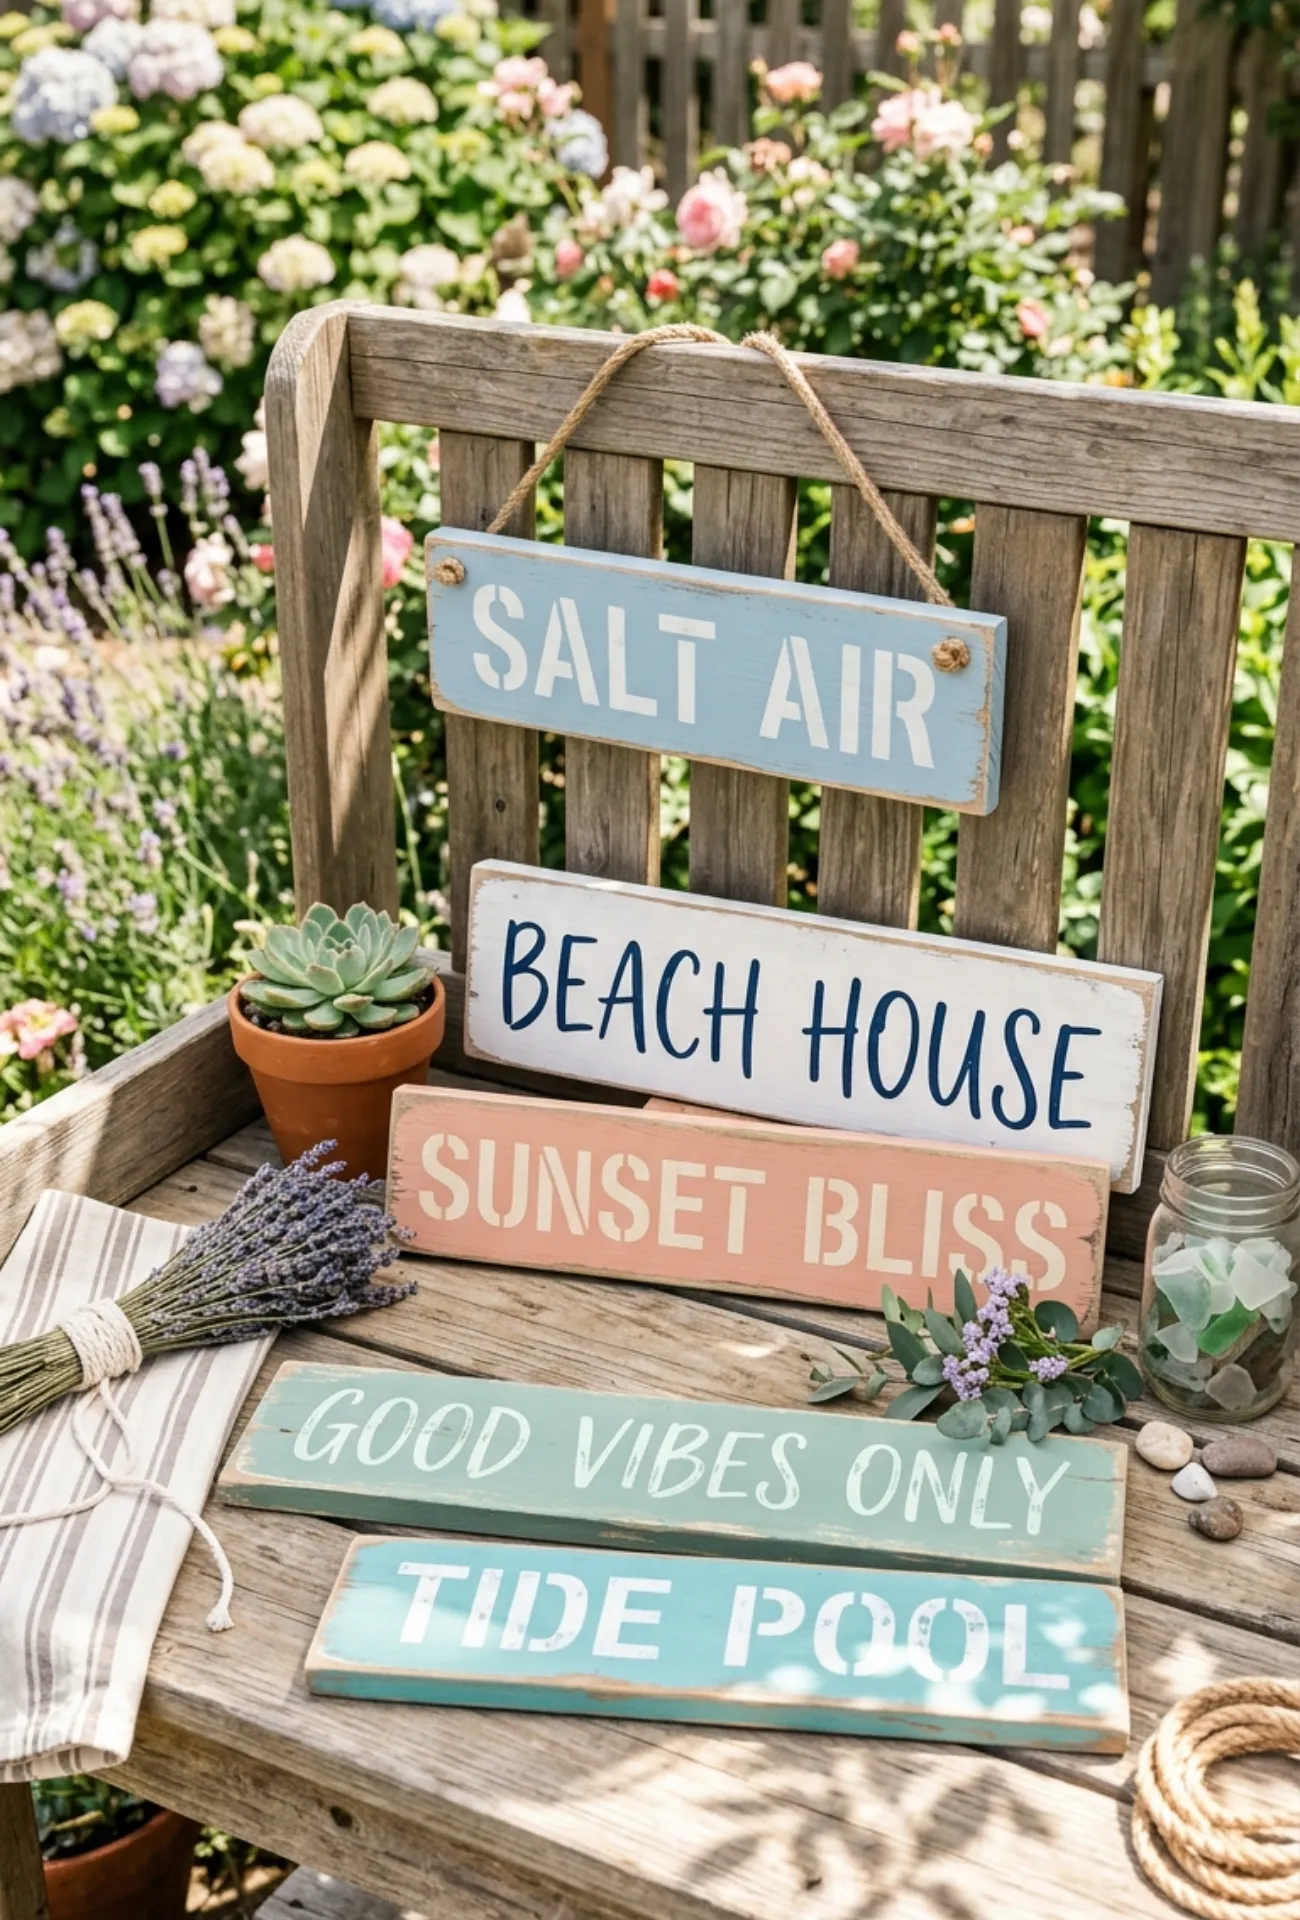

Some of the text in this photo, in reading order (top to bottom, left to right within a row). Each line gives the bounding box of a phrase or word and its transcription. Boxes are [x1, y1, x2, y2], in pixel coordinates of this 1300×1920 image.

[473, 584, 936, 769] SALT AIR
[502, 919, 1102, 1132] BEACH HOUSE
[419, 1133, 1068, 1292] SUNSET BLISS
[293, 1388, 1071, 1535] GOOD VIBES ONLY
[397, 1562, 1070, 1690] TIDE POOL
